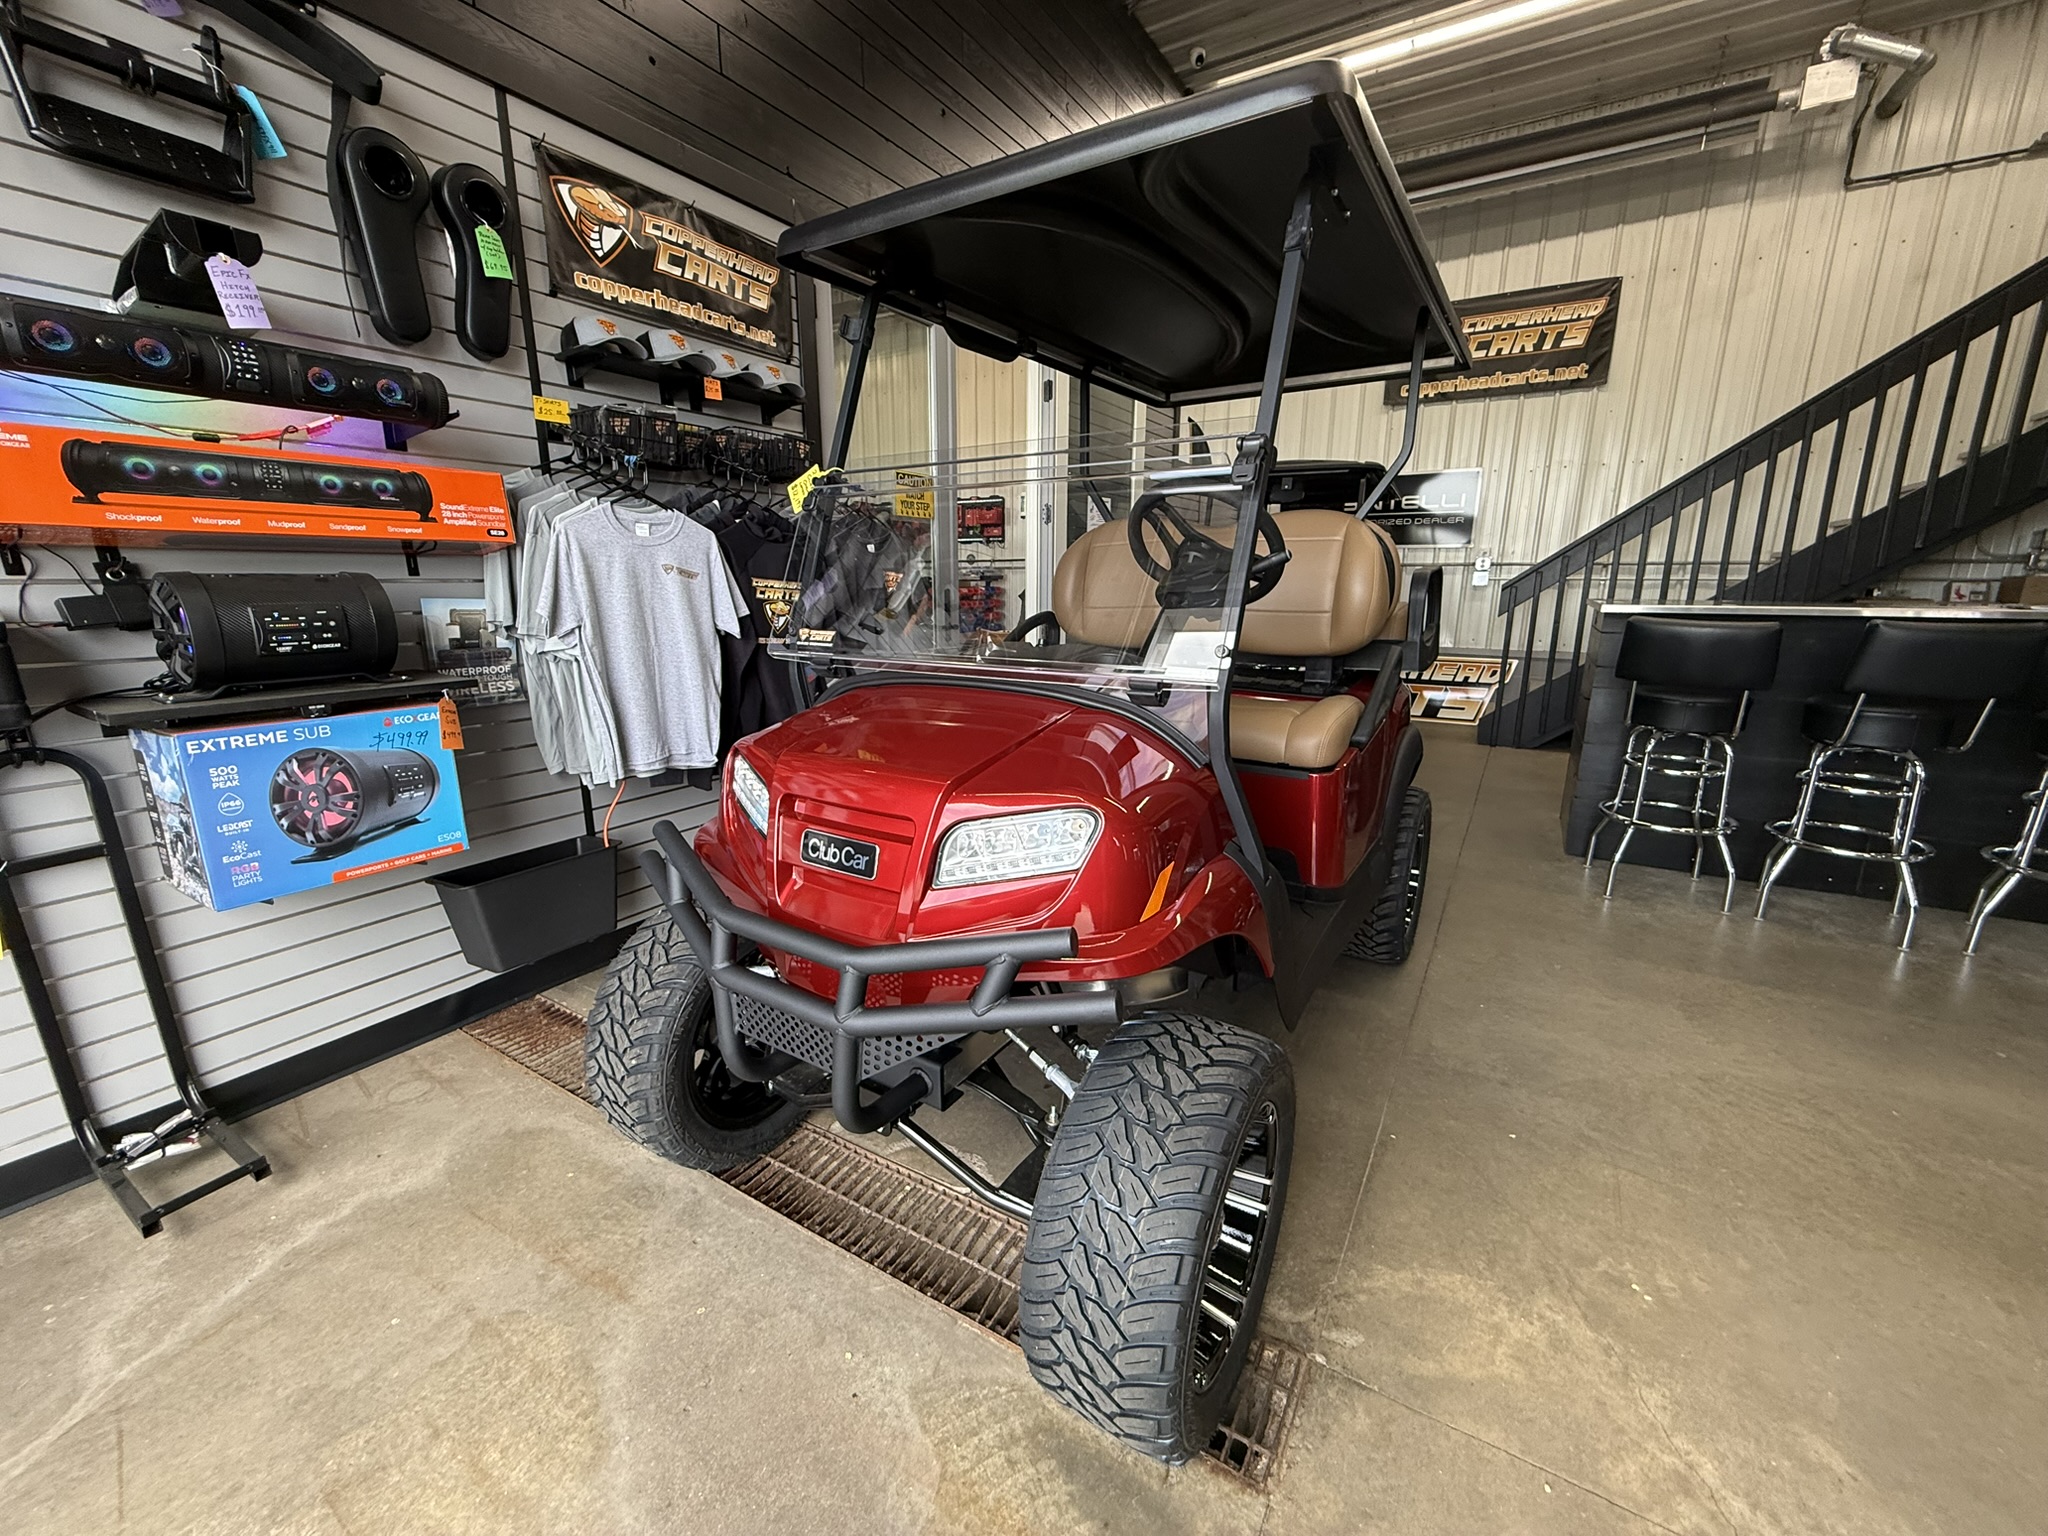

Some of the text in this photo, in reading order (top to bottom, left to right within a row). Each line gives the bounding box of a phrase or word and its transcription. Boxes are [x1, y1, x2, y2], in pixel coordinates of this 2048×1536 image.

[645, 215, 779, 284] COPPERHEAD
[656, 239, 771, 311] CARTS
[574, 271, 777, 347] copperheadcarts.net
[1462, 299, 1607, 333] COPPERHEAD
[1470, 319, 1593, 359] CARTS
[1400, 362, 1589, 399] cpperheadcarts.net
[897, 473, 933, 487] CAUTION
[900, 499, 930, 511] YOUR STEP
[105, 511, 423, 534] Shockproof Waterproof Mudproof Sandproof Snowproof
[1414, 516, 1464, 525] DEALER
[185, 725, 332, 754] EXTREME SUB
[369, 730, 428, 752] $499.99
[209, 765, 238, 777] 500
[211, 773, 239, 782] WATTS
[212, 779, 240, 790] PEAK
[222, 849, 262, 863] EcoCast
[808, 837, 870, 870] Club Car
[231, 862, 260, 874] RGB
[394, 857, 410, 866] GOLF
[232, 870, 261, 881] PARTY
[233, 876, 263, 888] LIGHTS
